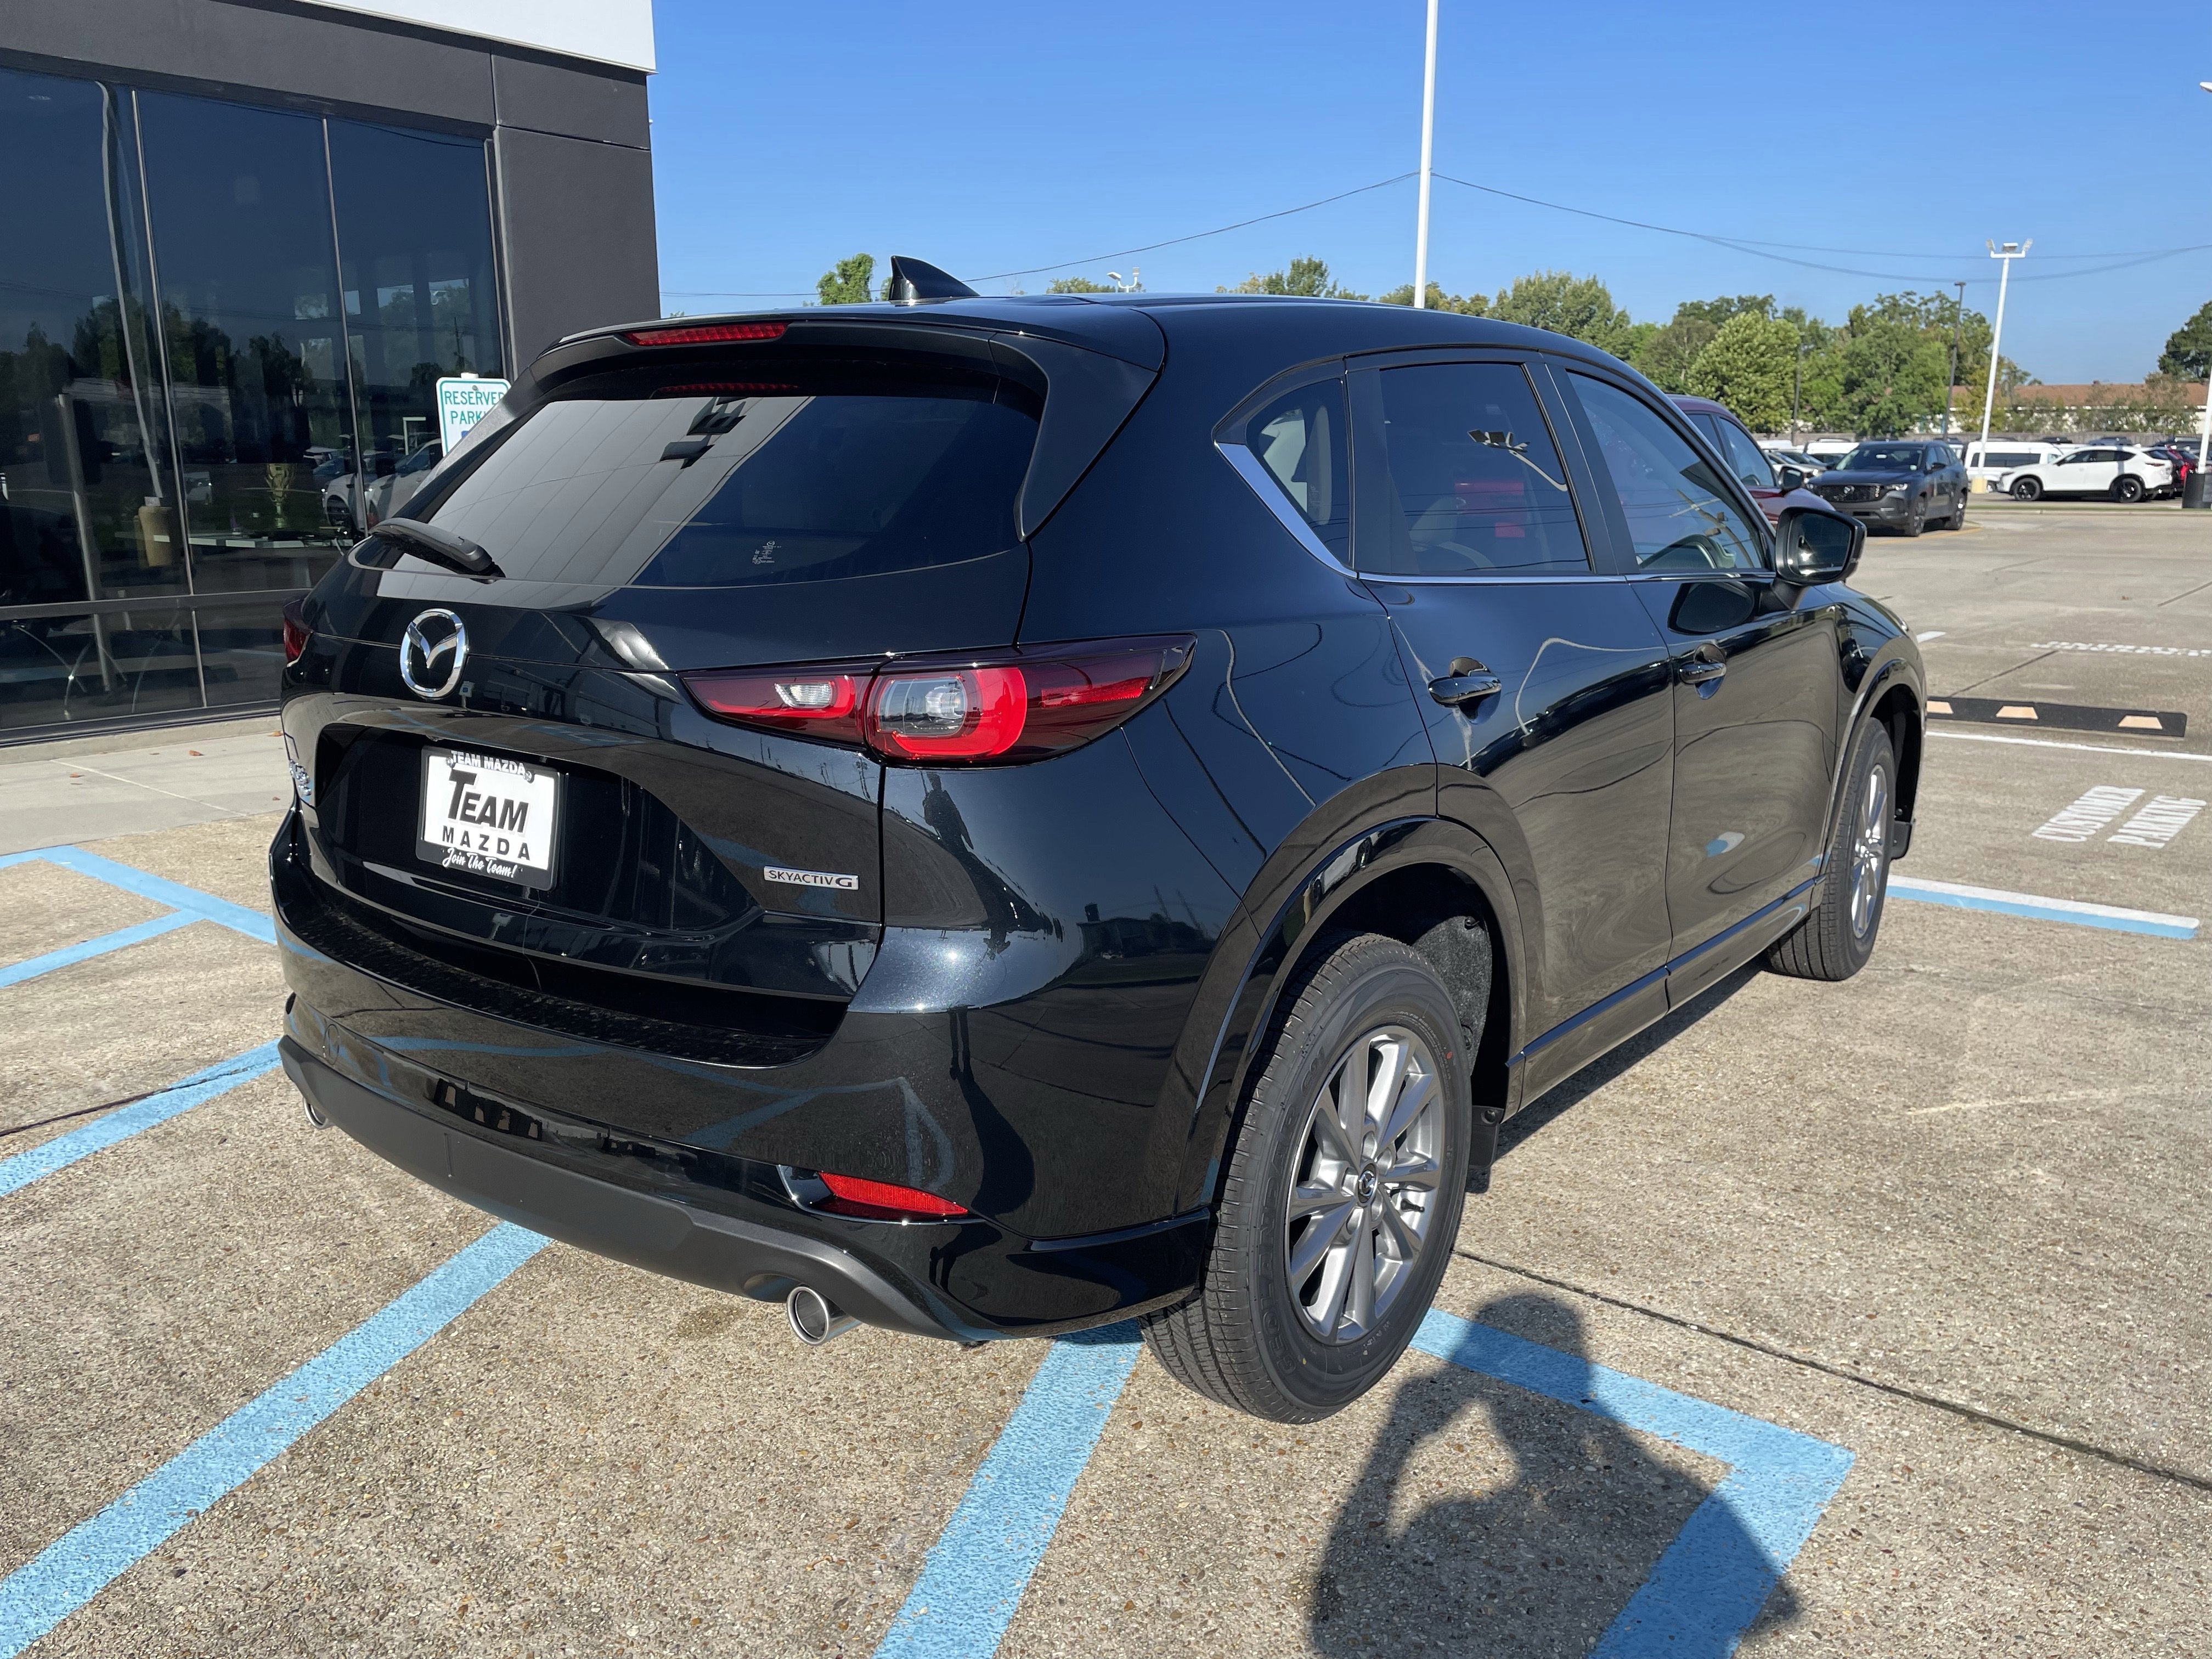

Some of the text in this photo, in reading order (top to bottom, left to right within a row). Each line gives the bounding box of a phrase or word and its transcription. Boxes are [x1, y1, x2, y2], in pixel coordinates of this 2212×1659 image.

[450, 411, 486, 425] PARK
[450, 750, 526, 776] TEAM MAZDA
[448, 769, 529, 833] TEAM
[2031, 786, 2146, 842] CUSTOMER
[2107, 795, 2207, 849] PARKING
[442, 825, 530, 861] MAZDA
[442, 848, 517, 878] Join The Team!
[1259, 1103, 1301, 1374] GEOLANDAR
